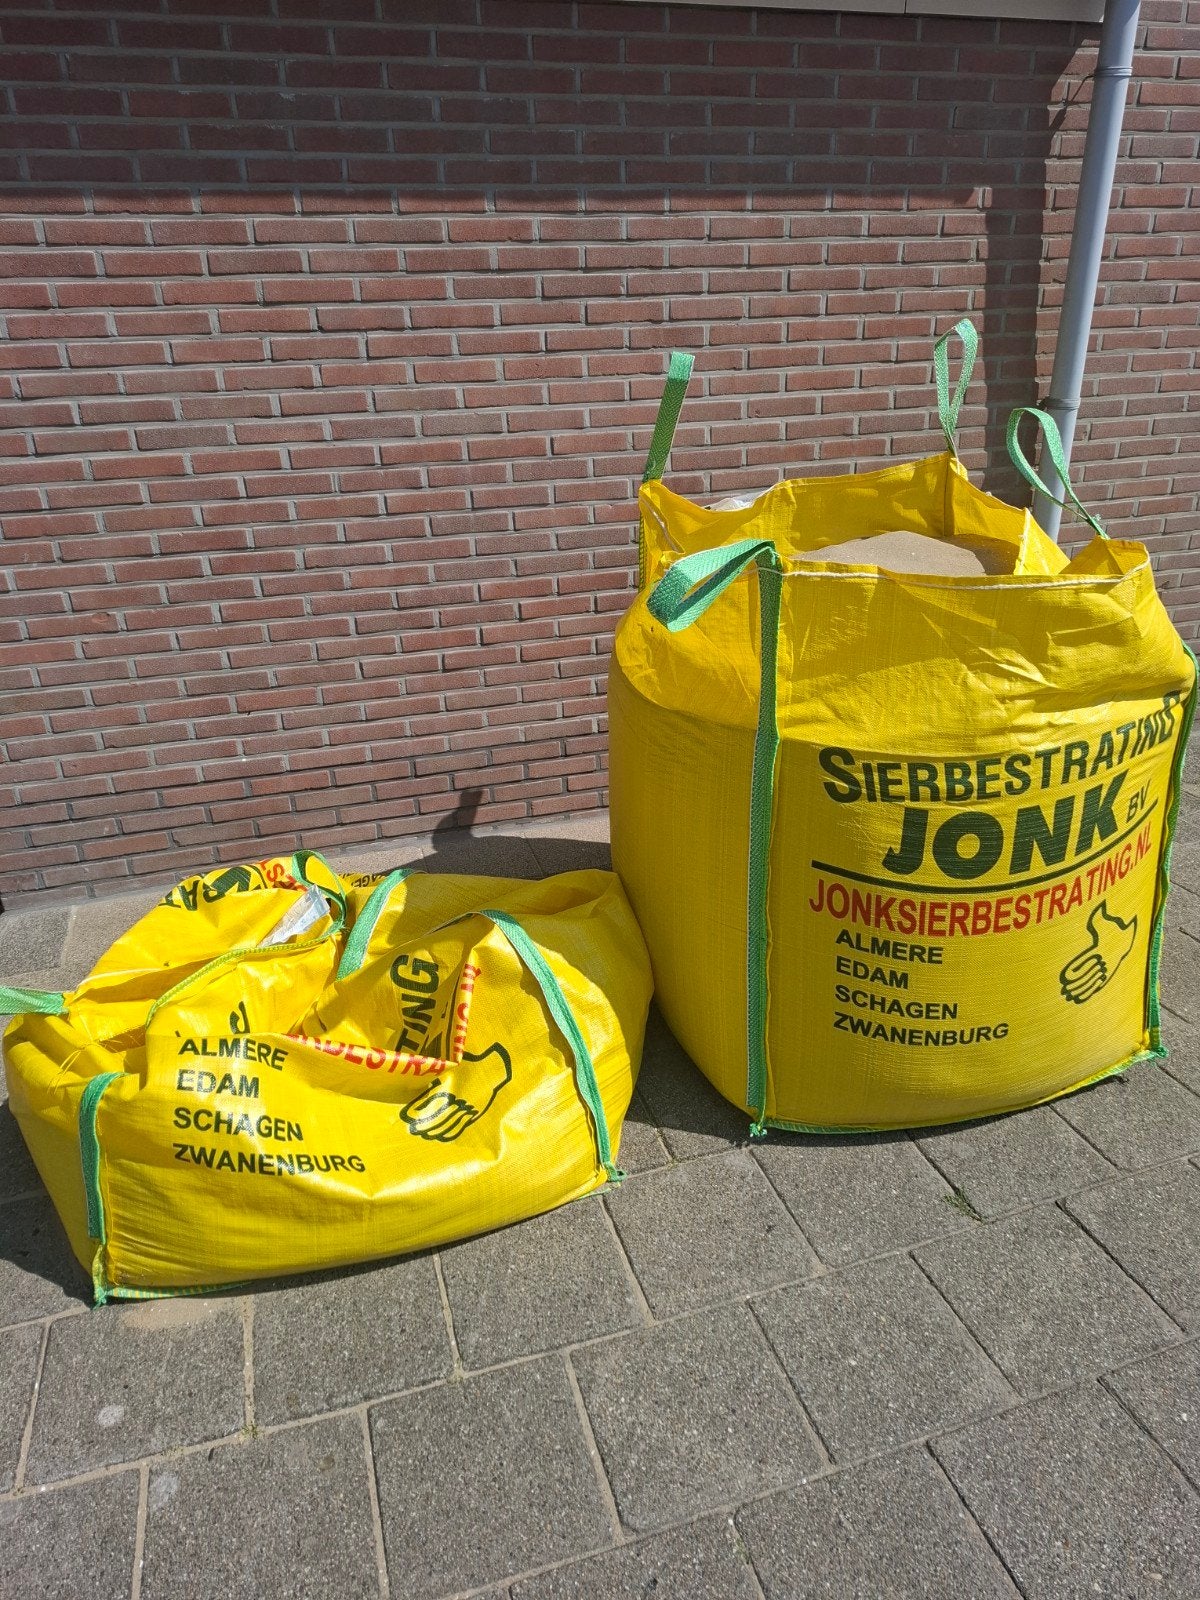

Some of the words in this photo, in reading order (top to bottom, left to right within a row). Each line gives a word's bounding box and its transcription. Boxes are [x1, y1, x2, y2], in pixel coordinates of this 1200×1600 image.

[882, 769, 1129, 879] JONK
[1126, 779, 1150, 824] BV
[809, 820, 1152, 937] JONKSIERBESTRATING.NL
[836, 929, 943, 964] ALMERE
[836, 955, 908, 989] EDAM
[835, 985, 958, 1019] SCHAGEN
[833, 1012, 1009, 1047] ZWANENBURG
[178, 1038, 288, 1071] ALMERE
[176, 1069, 260, 1098] EDAM
[173, 1107, 303, 1142] SCHAGEN
[173, 1143, 366, 1176] ZWANENBURG
